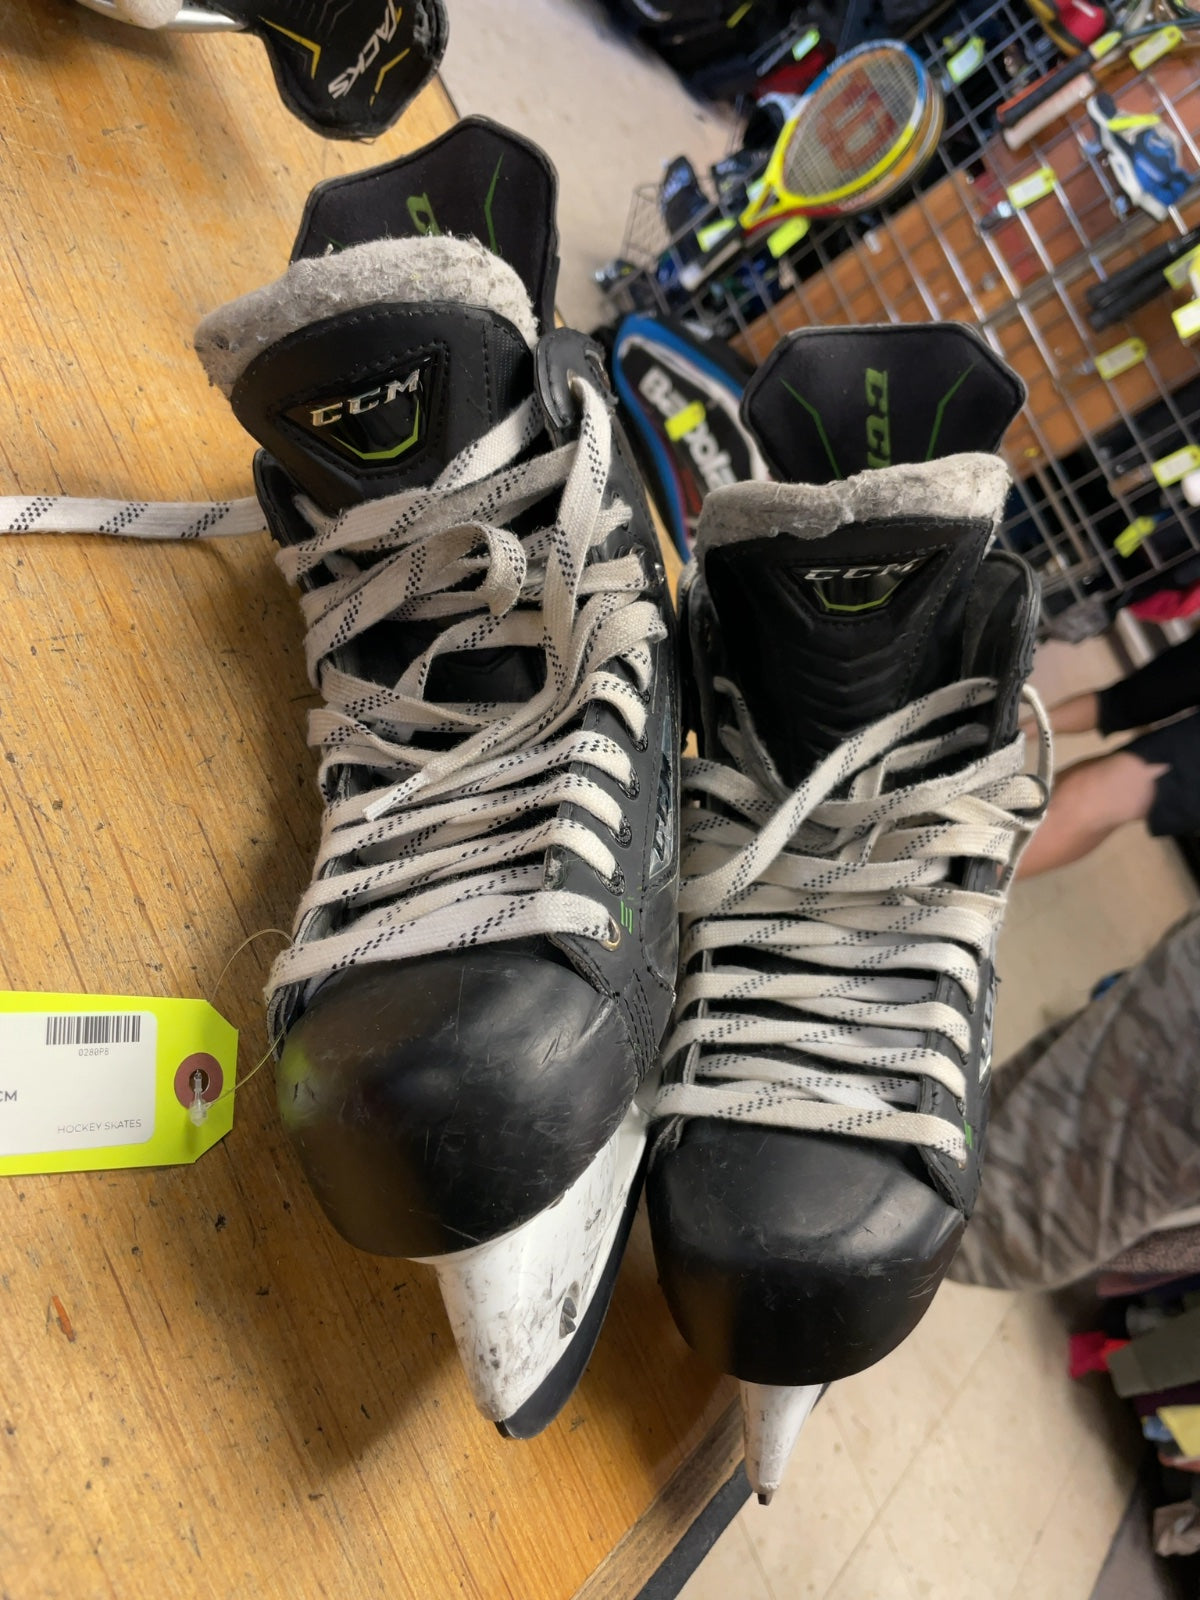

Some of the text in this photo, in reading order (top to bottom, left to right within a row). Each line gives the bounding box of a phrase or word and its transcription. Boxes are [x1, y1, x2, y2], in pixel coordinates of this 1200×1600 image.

[310, 368, 420, 427] CCM
[57, 1119, 142, 1134] HOCKEY SKATES
